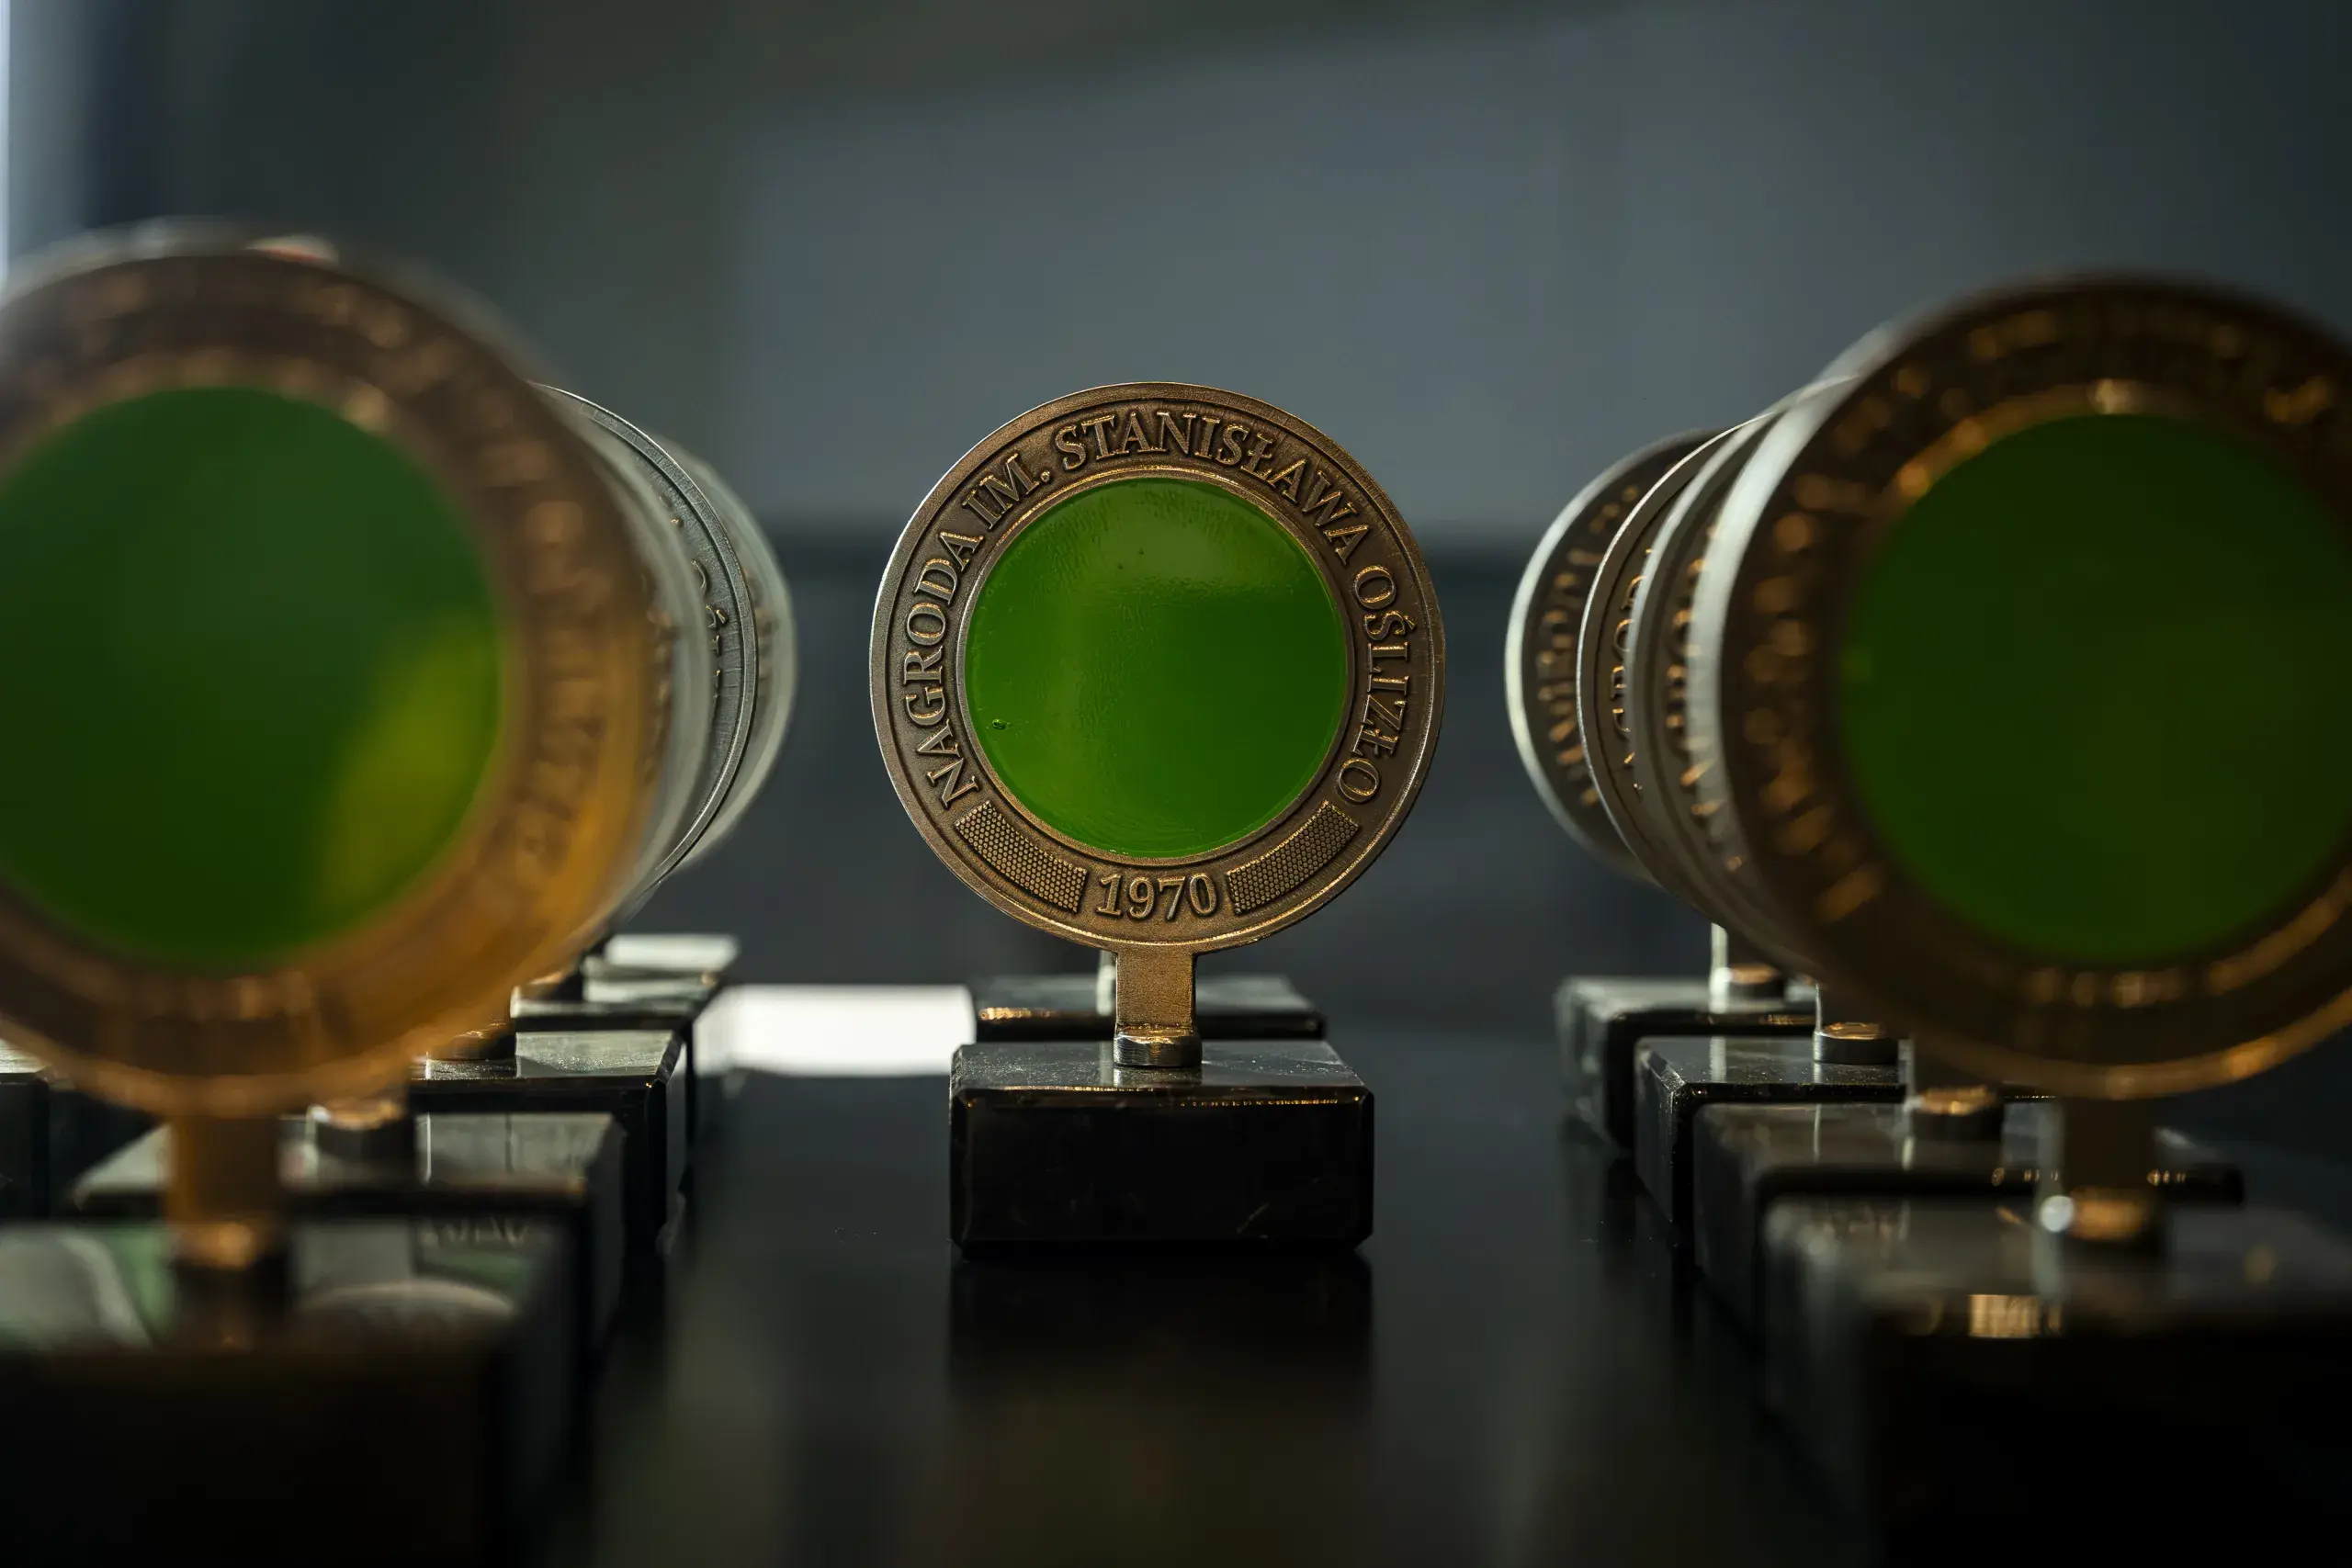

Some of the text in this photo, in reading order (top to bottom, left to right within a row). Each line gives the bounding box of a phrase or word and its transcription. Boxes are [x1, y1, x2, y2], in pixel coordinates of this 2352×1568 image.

[904, 531, 984, 807] NAGRODA
[962, 452, 1050, 530] IM.
[1054, 412, 1370, 563] STANISŁAWA
[1336, 565, 1417, 804] OŚLIZŁO
[1097, 874, 1218, 920] 1970
